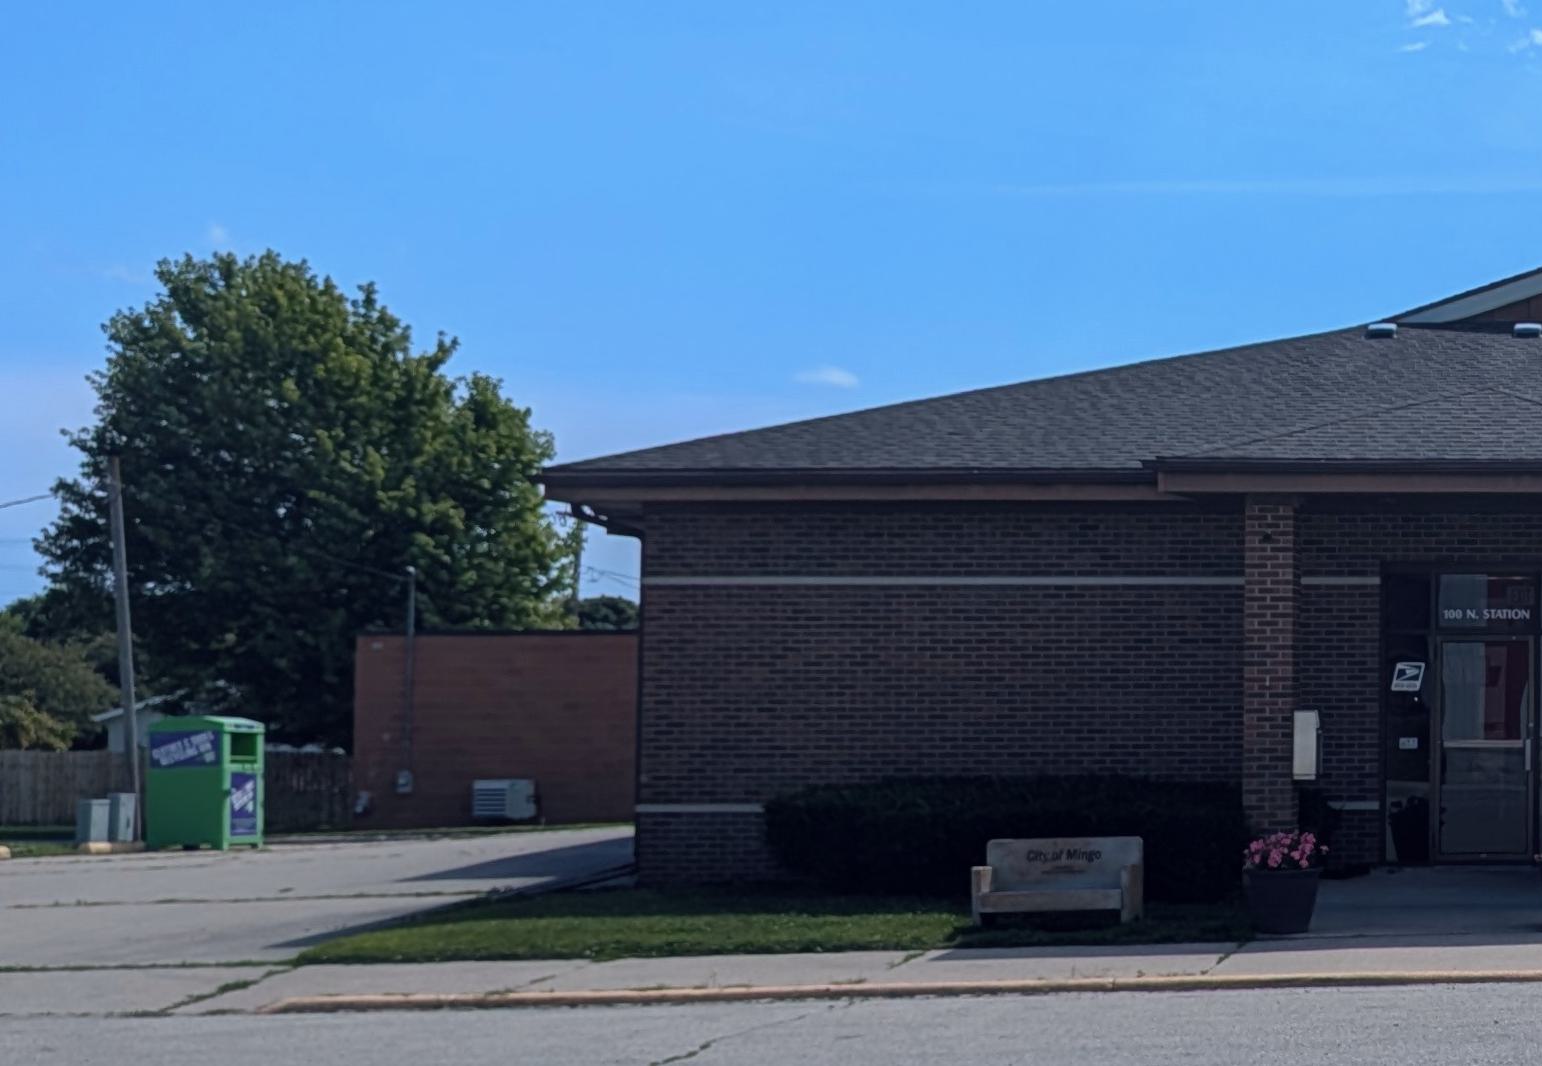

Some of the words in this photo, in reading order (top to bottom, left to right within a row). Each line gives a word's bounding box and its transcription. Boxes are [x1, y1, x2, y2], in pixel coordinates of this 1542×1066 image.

[1443, 608, 1463, 620] 100
[1466, 608, 1480, 620] N.
[1482, 608, 1531, 620] STATION
[1026, 848, 1047, 864] City
[1051, 849, 1064, 862] of
[1066, 848, 1102, 863] Mingo
